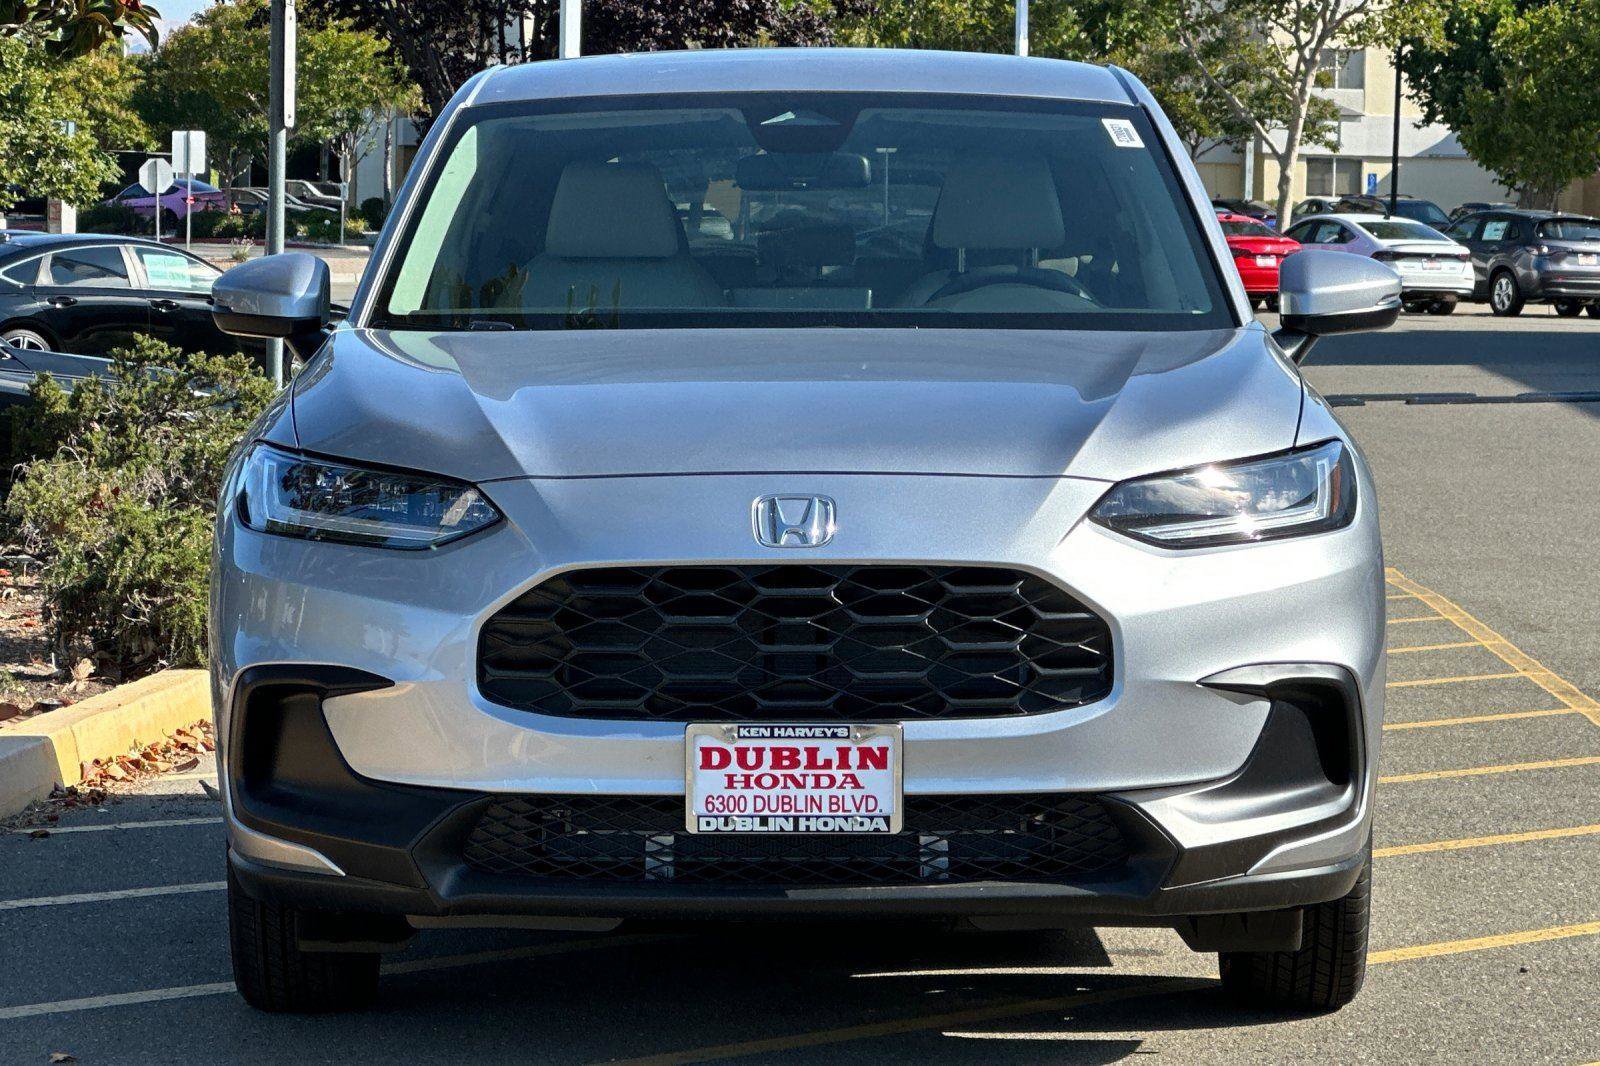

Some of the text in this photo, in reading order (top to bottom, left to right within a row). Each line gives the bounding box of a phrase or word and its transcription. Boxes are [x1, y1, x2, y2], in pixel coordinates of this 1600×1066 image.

[739, 727, 849, 738] KEN HARVEY'S
[699, 746, 889, 771] DUBLIN
[724, 772, 865, 790] HONDA
[705, 794, 883, 813] 6300 DUBLIN BLVD.
[699, 817, 889, 832] DUBLIN HONDA
